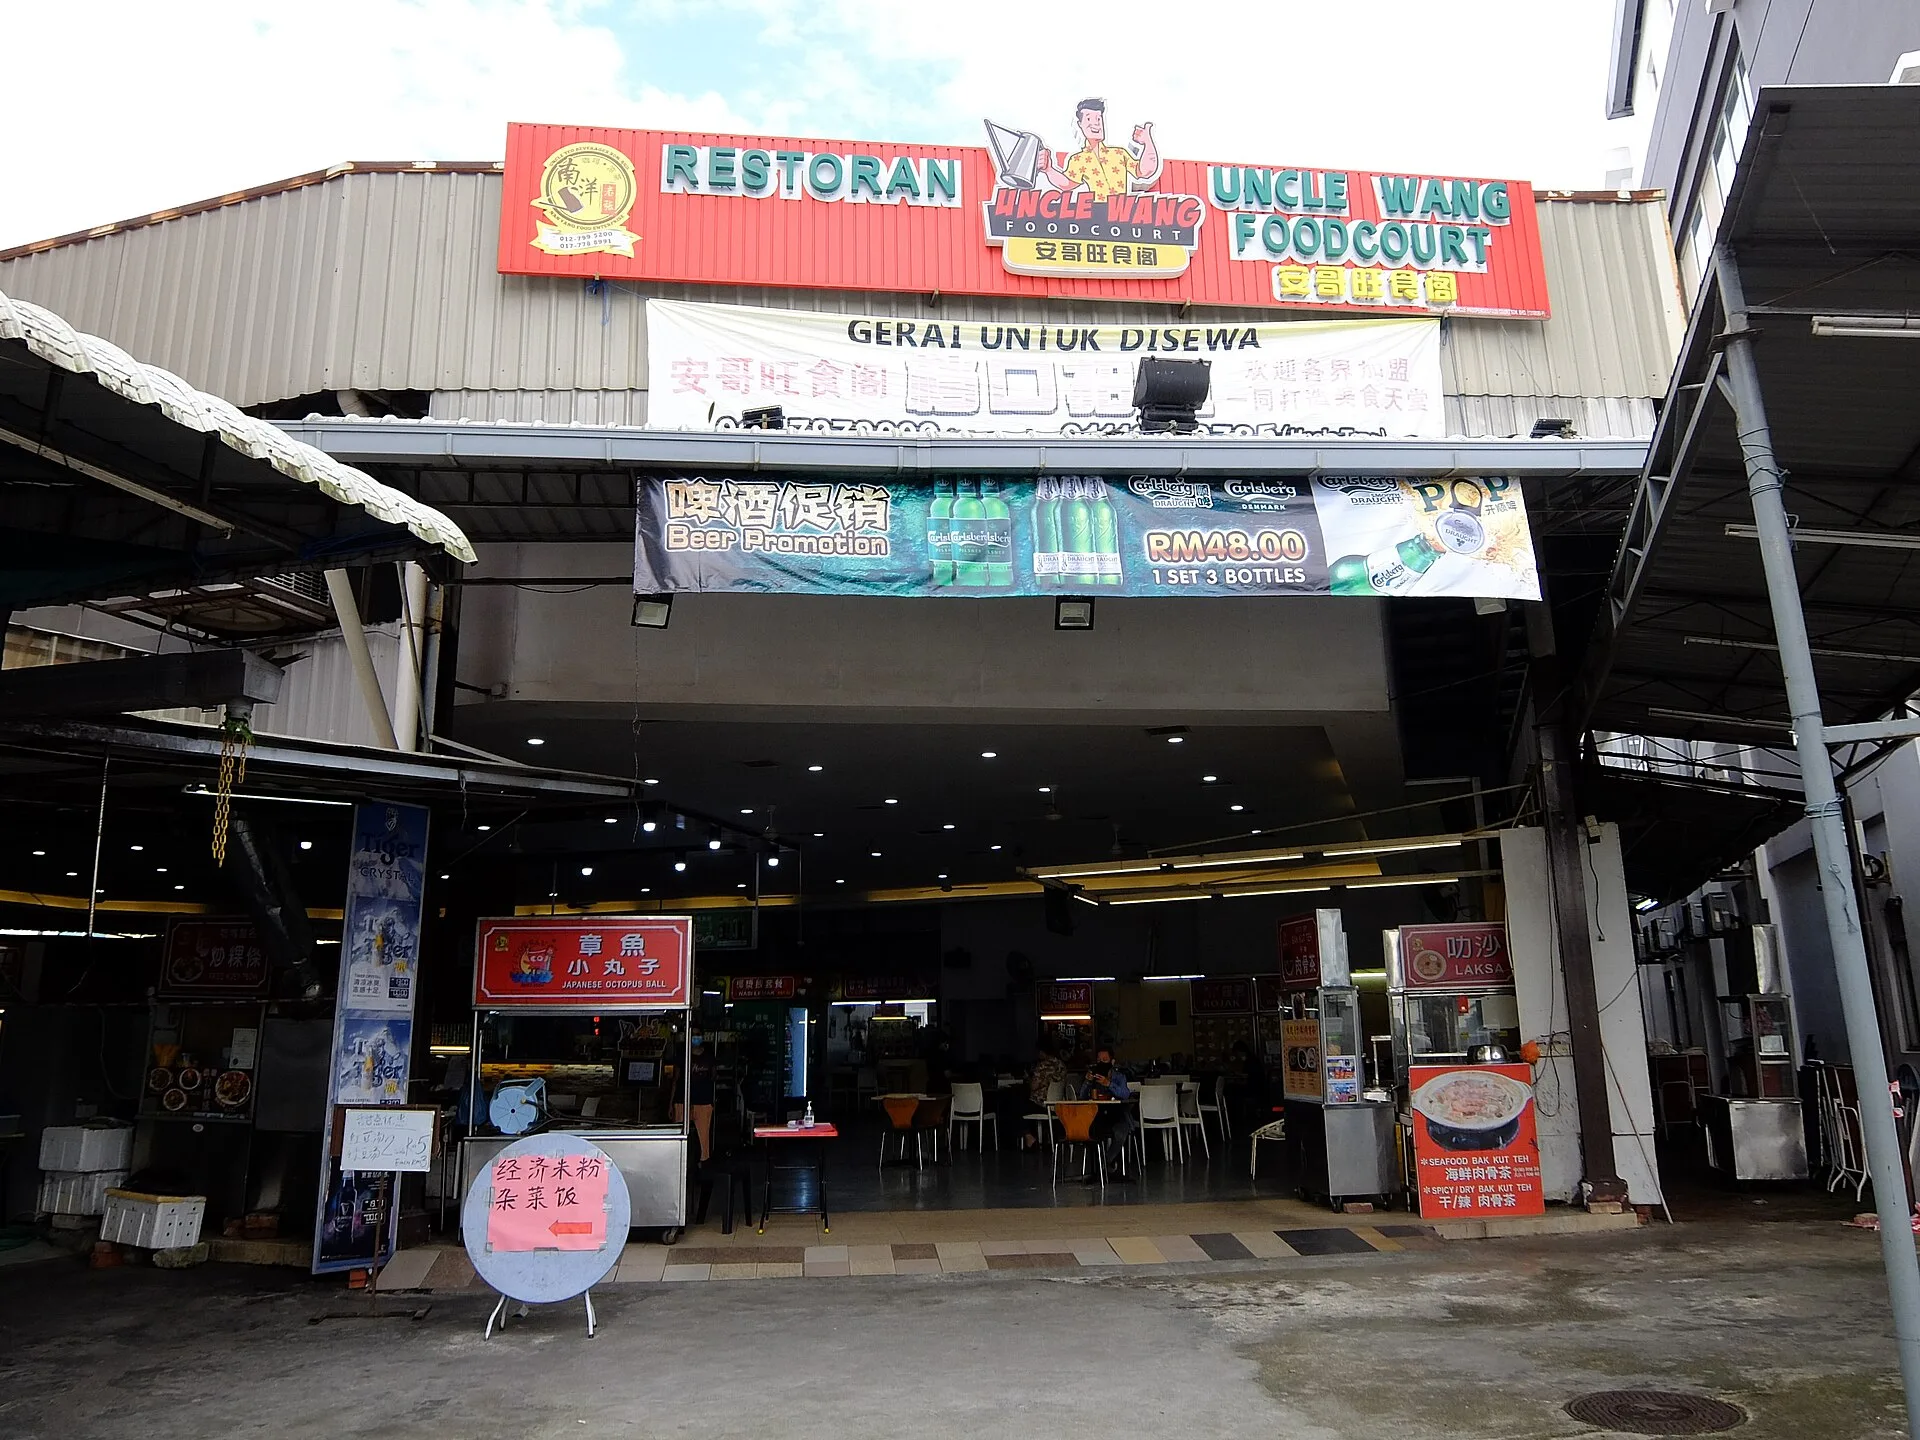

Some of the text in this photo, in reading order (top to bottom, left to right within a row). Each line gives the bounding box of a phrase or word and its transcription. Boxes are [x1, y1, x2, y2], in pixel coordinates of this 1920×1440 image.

[557, 157, 599, 206] 南洋
[664, 144, 957, 202] RESTORAN
[1212, 167, 1510, 222] UNCLE WANG
[995, 188, 1202, 227] UNCLE WANG
[1005, 220, 1182, 241] FOODCOURT
[1236, 213, 1490, 267] FOODCOURT
[1036, 240, 1158, 266] 安哥旺食阁
[1276, 266, 1457, 303] 安哥旺食阁
[847, 320, 961, 349] GERAI
[1120, 327, 1263, 353] DISEWA
[1129, 475, 1195, 496] Carlsberg
[1224, 480, 1296, 498] Carlsberg
[665, 480, 890, 531] 啤酒促销
[666, 524, 889, 556] Beer Promotion
[1147, 530, 1306, 562] RM48.00
[1151, 568, 1306, 585] 1 SET 3 BOTTLES
[360, 831, 420, 865] Tiger
[360, 866, 414, 882] CRYSTAL
[579, 933, 645, 957] 章魚
[1445, 934, 1501, 959] 叻沙
[567, 958, 660, 976] 小丸子
[1455, 963, 1505, 975] LAKSA
[562, 980, 666, 988] JAPANESE OCTOPUS BALL
[496, 1157, 602, 1183] 经济米粉
[1429, 1154, 1530, 1166] SEAFOOD BAK KUT TEH
[495, 1186, 580, 1211] 杂菜饭
[1478, 1184, 1495, 1193] BAK
[1499, 1184, 1513, 1192] KUT
[1516, 1183, 1532, 1192] TEH
[1478, 1193, 1516, 1208] 肉骨茶
